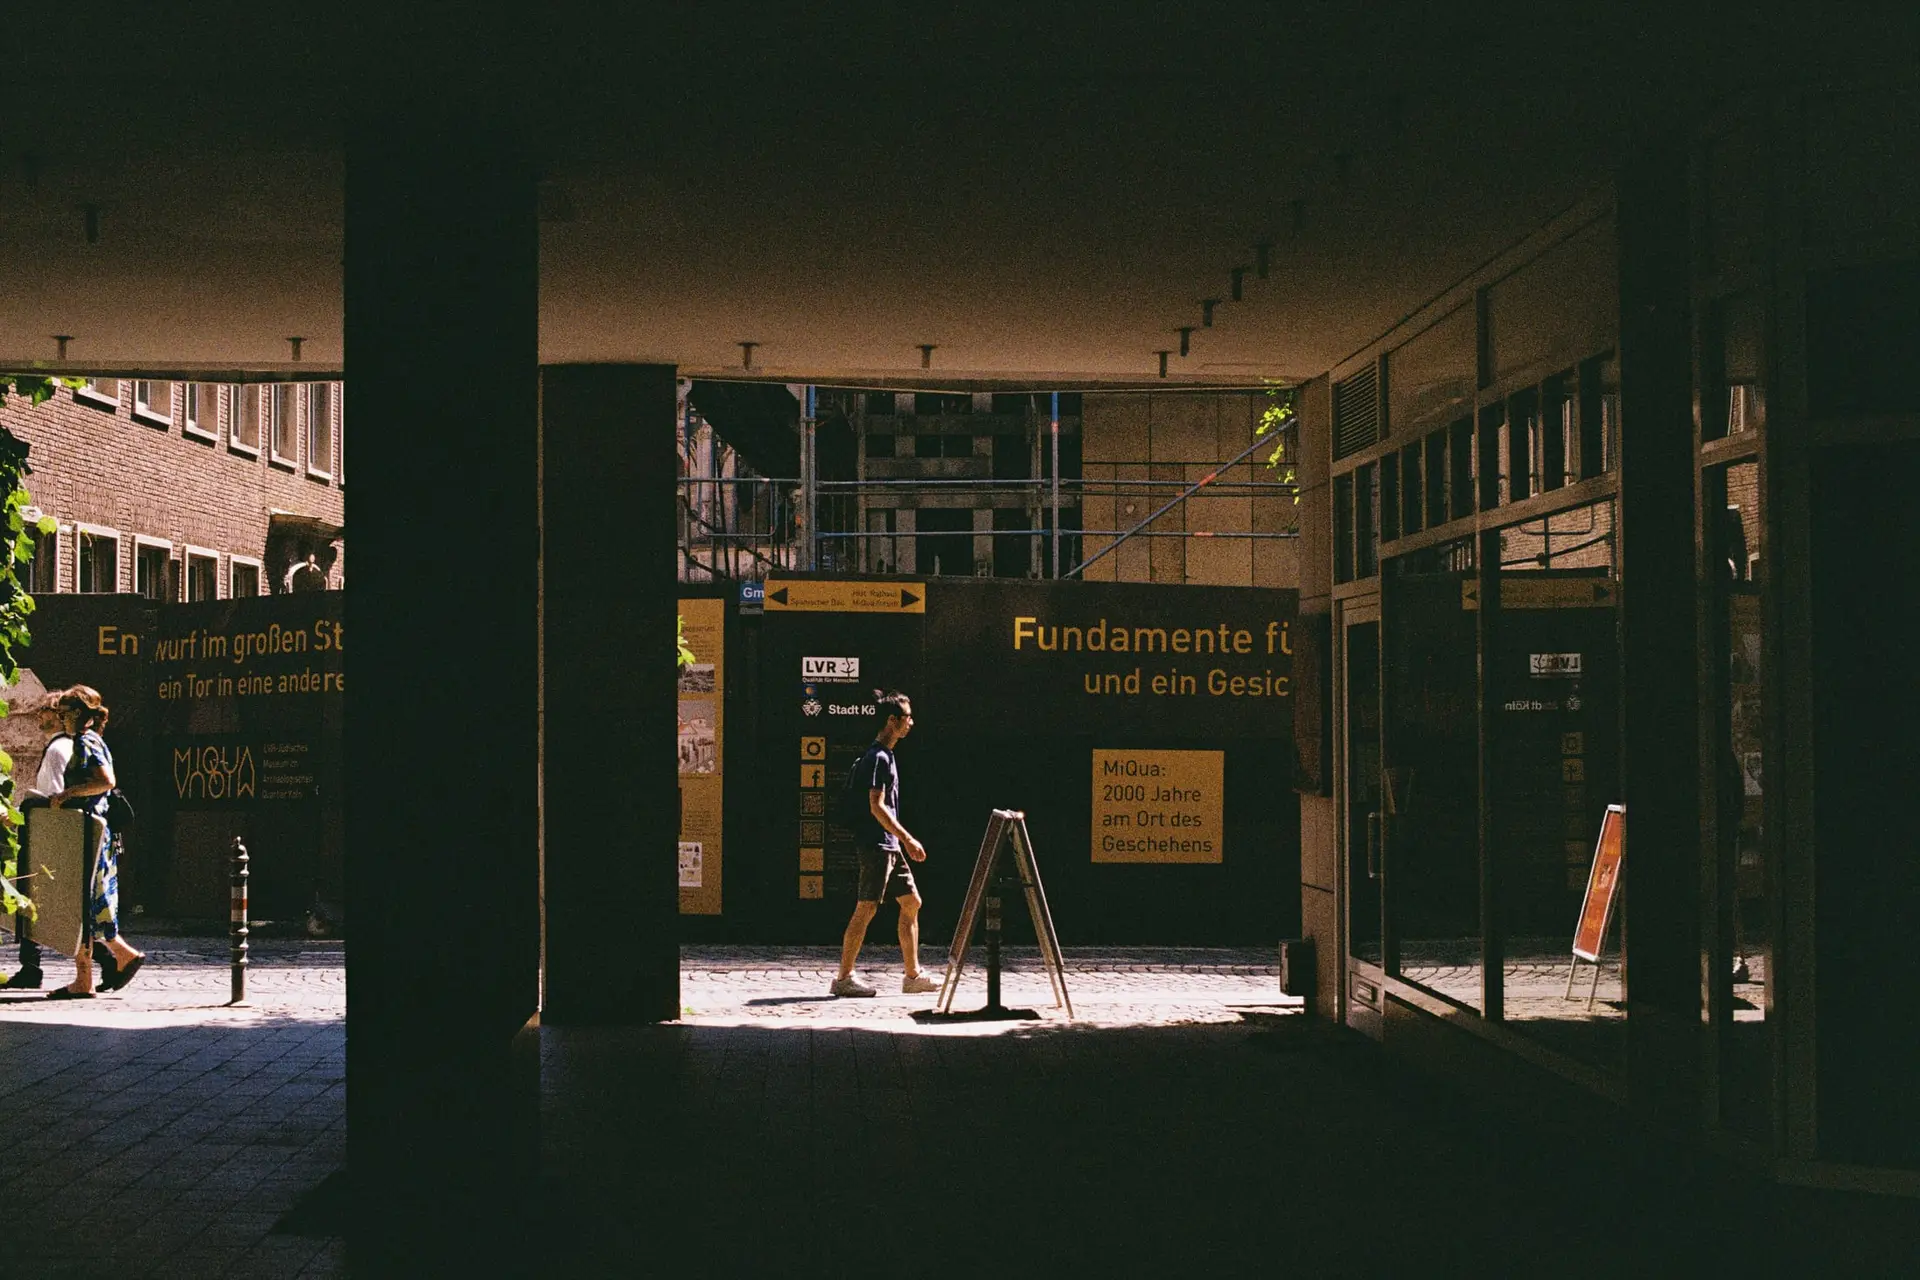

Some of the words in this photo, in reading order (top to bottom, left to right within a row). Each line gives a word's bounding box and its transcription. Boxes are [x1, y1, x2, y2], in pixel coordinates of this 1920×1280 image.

[743, 587, 765, 598] Gm
[202, 628, 227, 659] im
[232, 623, 308, 664] großen
[314, 619, 344, 652] St
[1013, 616, 1253, 654] Fundamente
[806, 660, 837, 673] LVR
[158, 675, 181, 699] ein
[186, 672, 214, 698] Tor
[217, 671, 233, 697] in
[237, 670, 273, 695] eine
[1085, 668, 1141, 695] und
[1151, 668, 1196, 696] ein
[1207, 668, 1290, 697] Gesic
[828, 704, 860, 716] Stadt
[1103, 759, 1167, 778] MiQua:
[1103, 785, 1145, 802] 2000
[1150, 785, 1202, 803] Jahre
[1102, 812, 1130, 827] am
[1136, 810, 1164, 827] Ort
[1170, 810, 1202, 827] des
[1102, 835, 1213, 853] Geschehens
